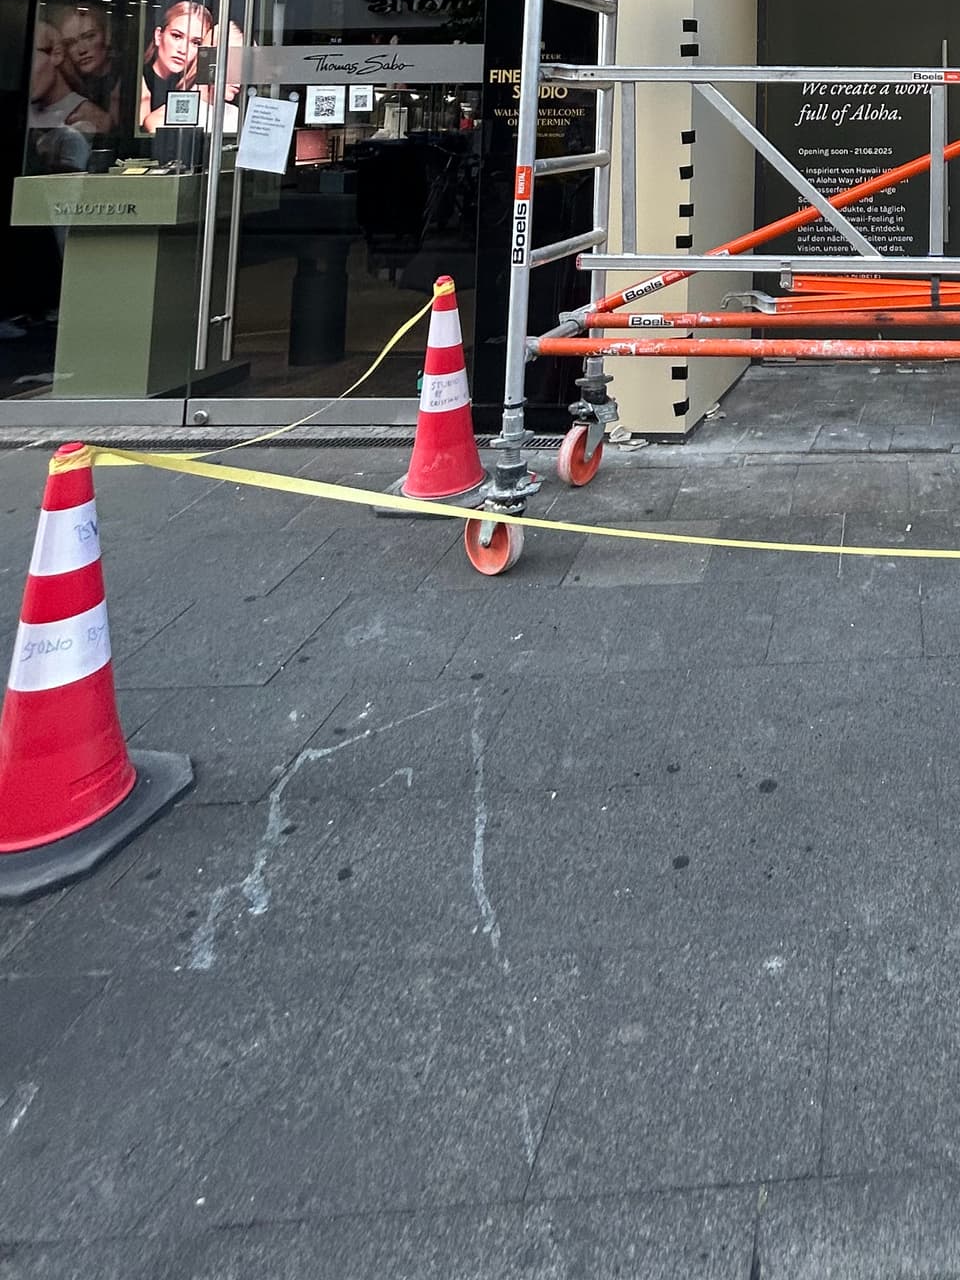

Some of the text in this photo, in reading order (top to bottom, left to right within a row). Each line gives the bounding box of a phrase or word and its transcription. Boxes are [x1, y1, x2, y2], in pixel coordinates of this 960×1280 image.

[303, 53, 415, 75] Thomas Sabo
[802, 82, 932, 95] We create a worl
[539, 108, 585, 117] WELCOME
[794, 103, 902, 126] full of Aloha.
[798, 148, 829, 157] Opening
[806, 167, 839, 175] inspiriert
[816, 176, 837, 184] Aloha
[838, 176, 854, 185] Way
[54, 202, 137, 216] SABOTEUR
[880, 205, 906, 215] täglich
[870, 224, 905, 232] Entdecke
[513, 203, 527, 264] Boels
[797, 234, 810, 242] auf
[811, 234, 826, 242] den
[625, 280, 662, 301] Boels
[631, 317, 672, 326] Boels
